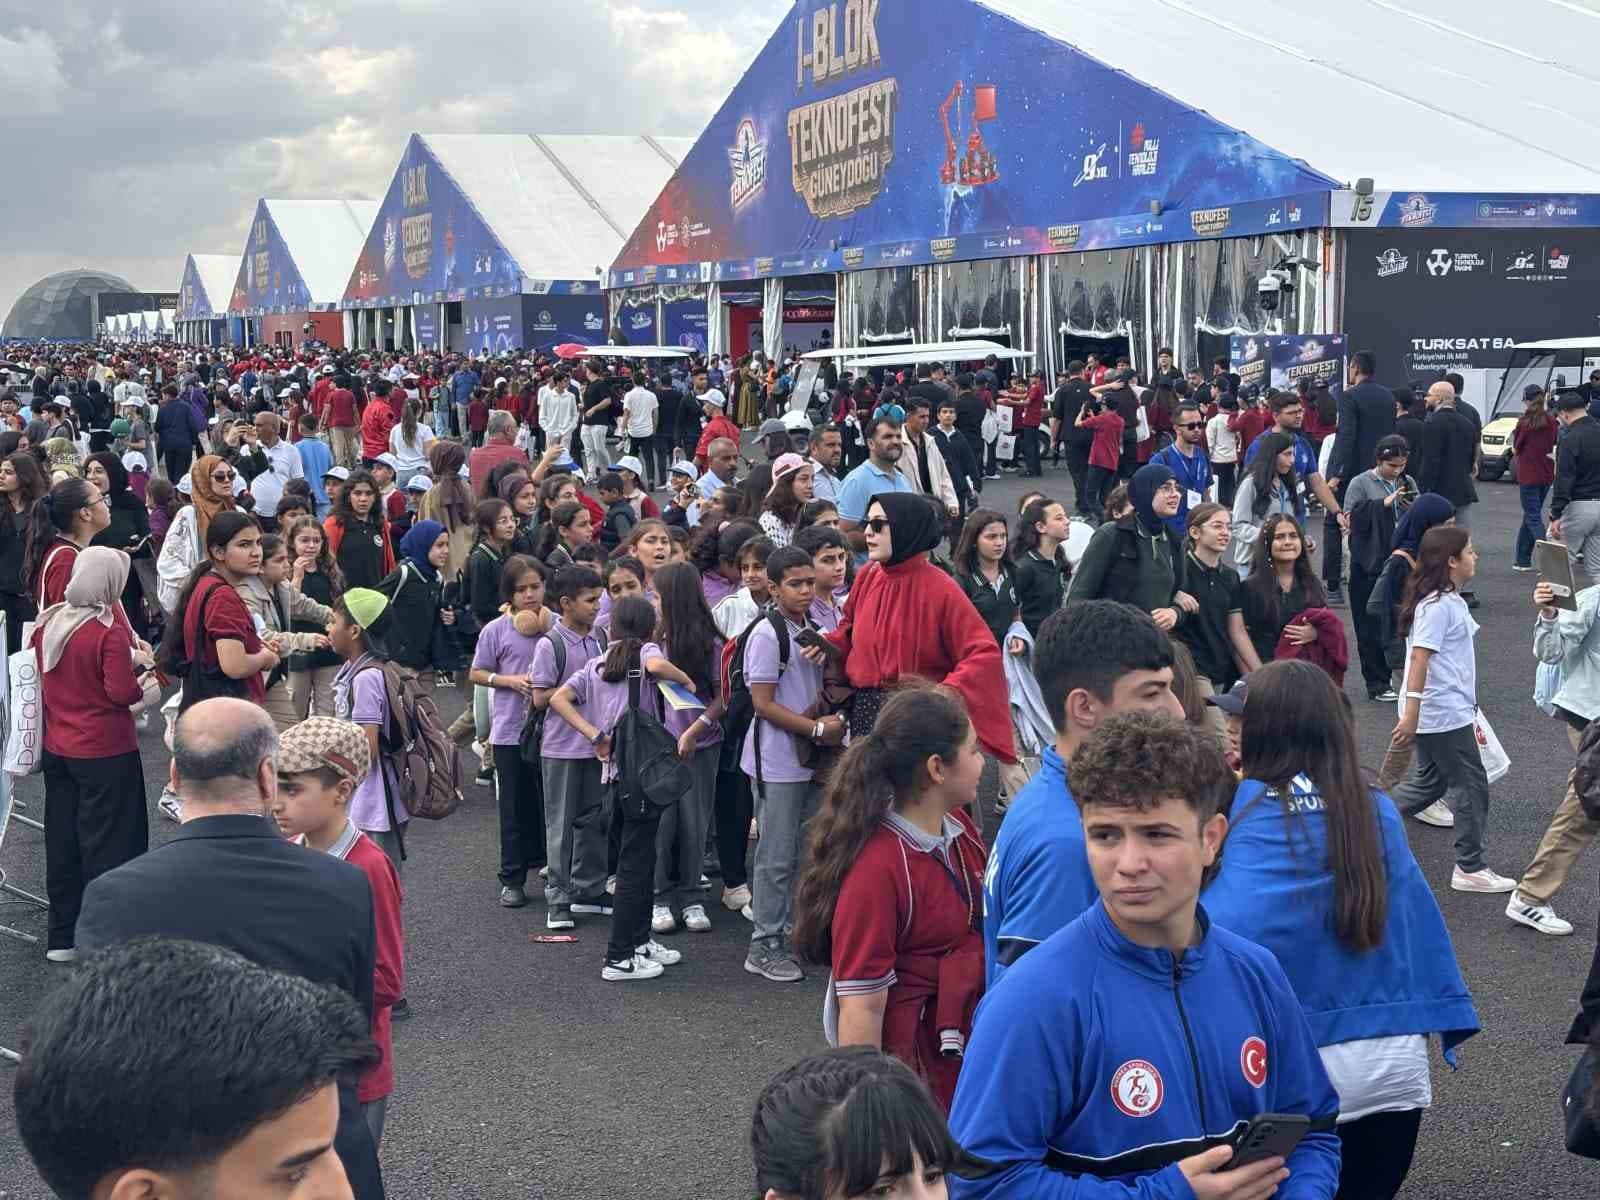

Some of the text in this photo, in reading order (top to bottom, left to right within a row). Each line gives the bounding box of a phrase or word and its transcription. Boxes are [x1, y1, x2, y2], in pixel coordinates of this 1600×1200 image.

[789, 82, 896, 162] TEKNOFEST
[809, 149, 879, 198] GÜNEYDOĞU
[1190, 208, 1230, 225] TEKNOFEST
[1492, 337, 1514, 349] 6A
[1287, 360, 1338, 379] TEKNOFEST
[16, 664, 36, 766] DeFacto
